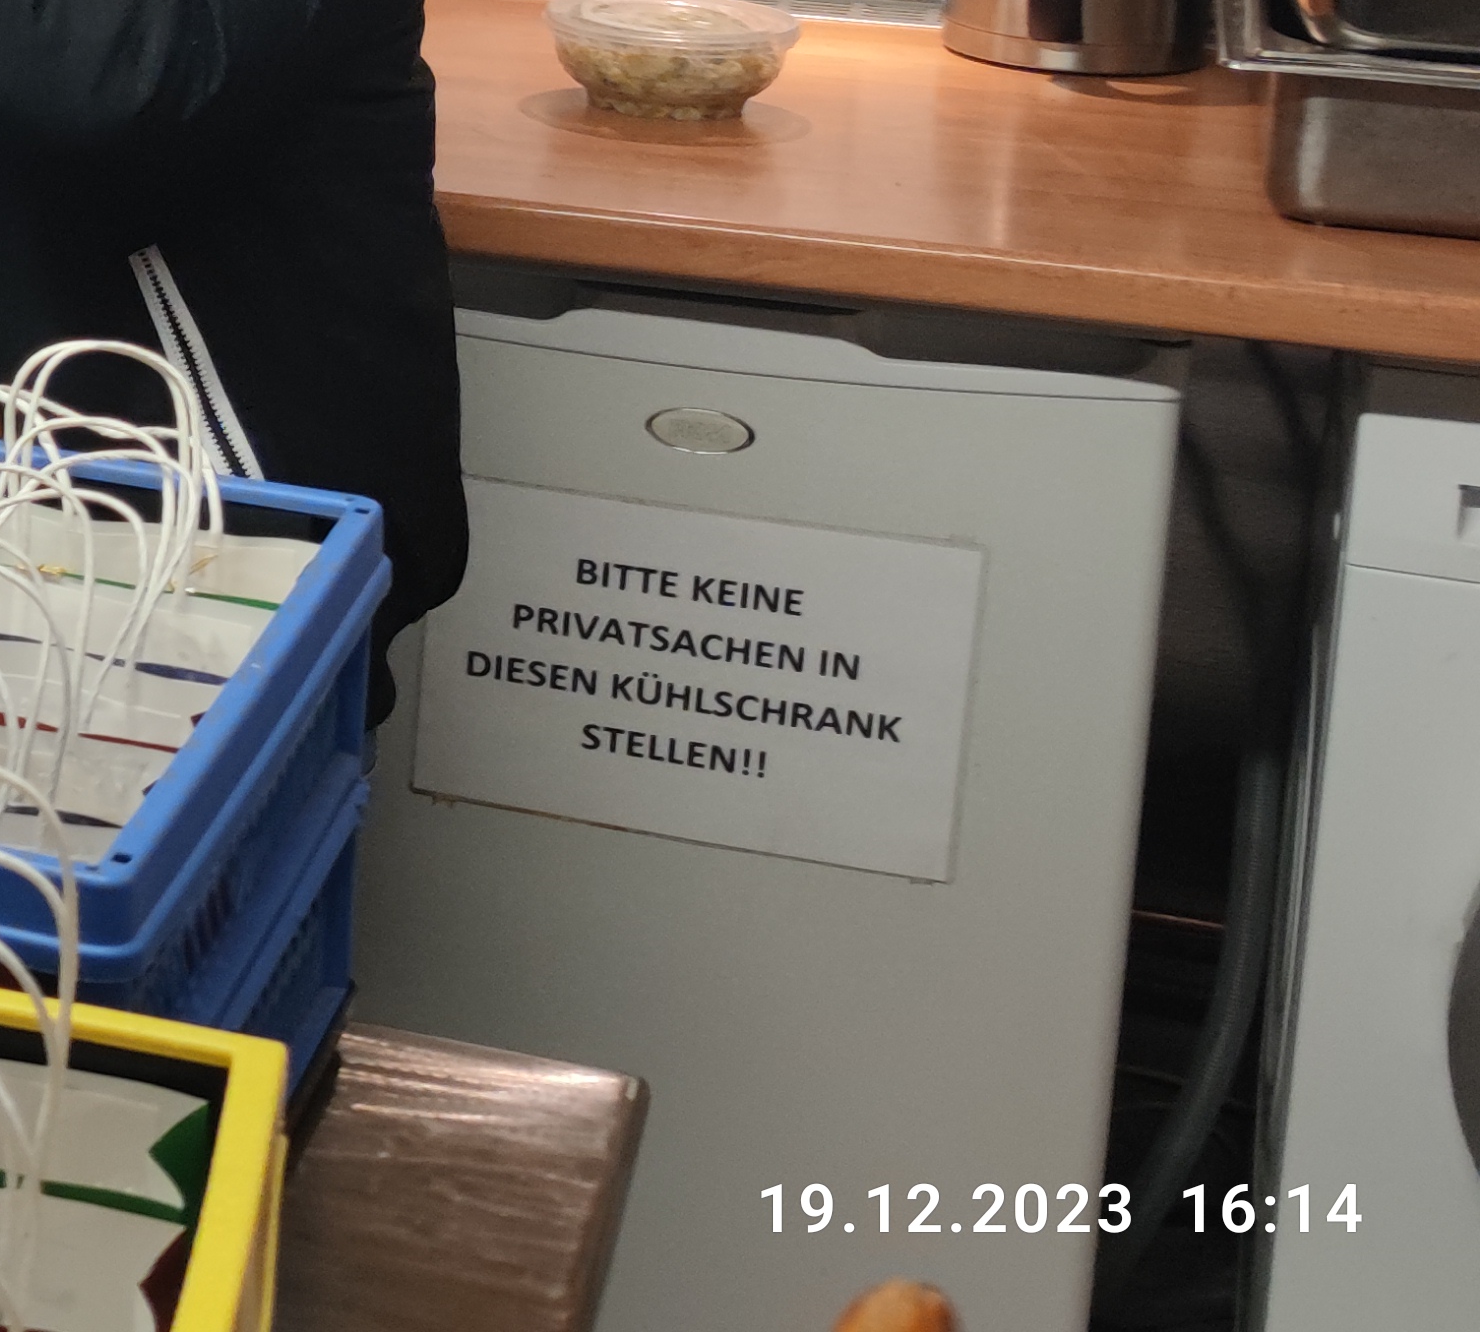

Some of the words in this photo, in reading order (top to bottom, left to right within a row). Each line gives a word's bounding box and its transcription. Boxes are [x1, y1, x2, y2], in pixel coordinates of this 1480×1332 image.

[576, 558, 679, 598] BITTE
[692, 575, 804, 617] KEINE
[512, 603, 805, 673] PRIVATSACHEN
[819, 650, 860, 681] IN
[464, 650, 599, 696] DIESEN
[611, 670, 902, 743] KÜHLSCHRANK
[580, 723, 767, 778] STELLEN!!
